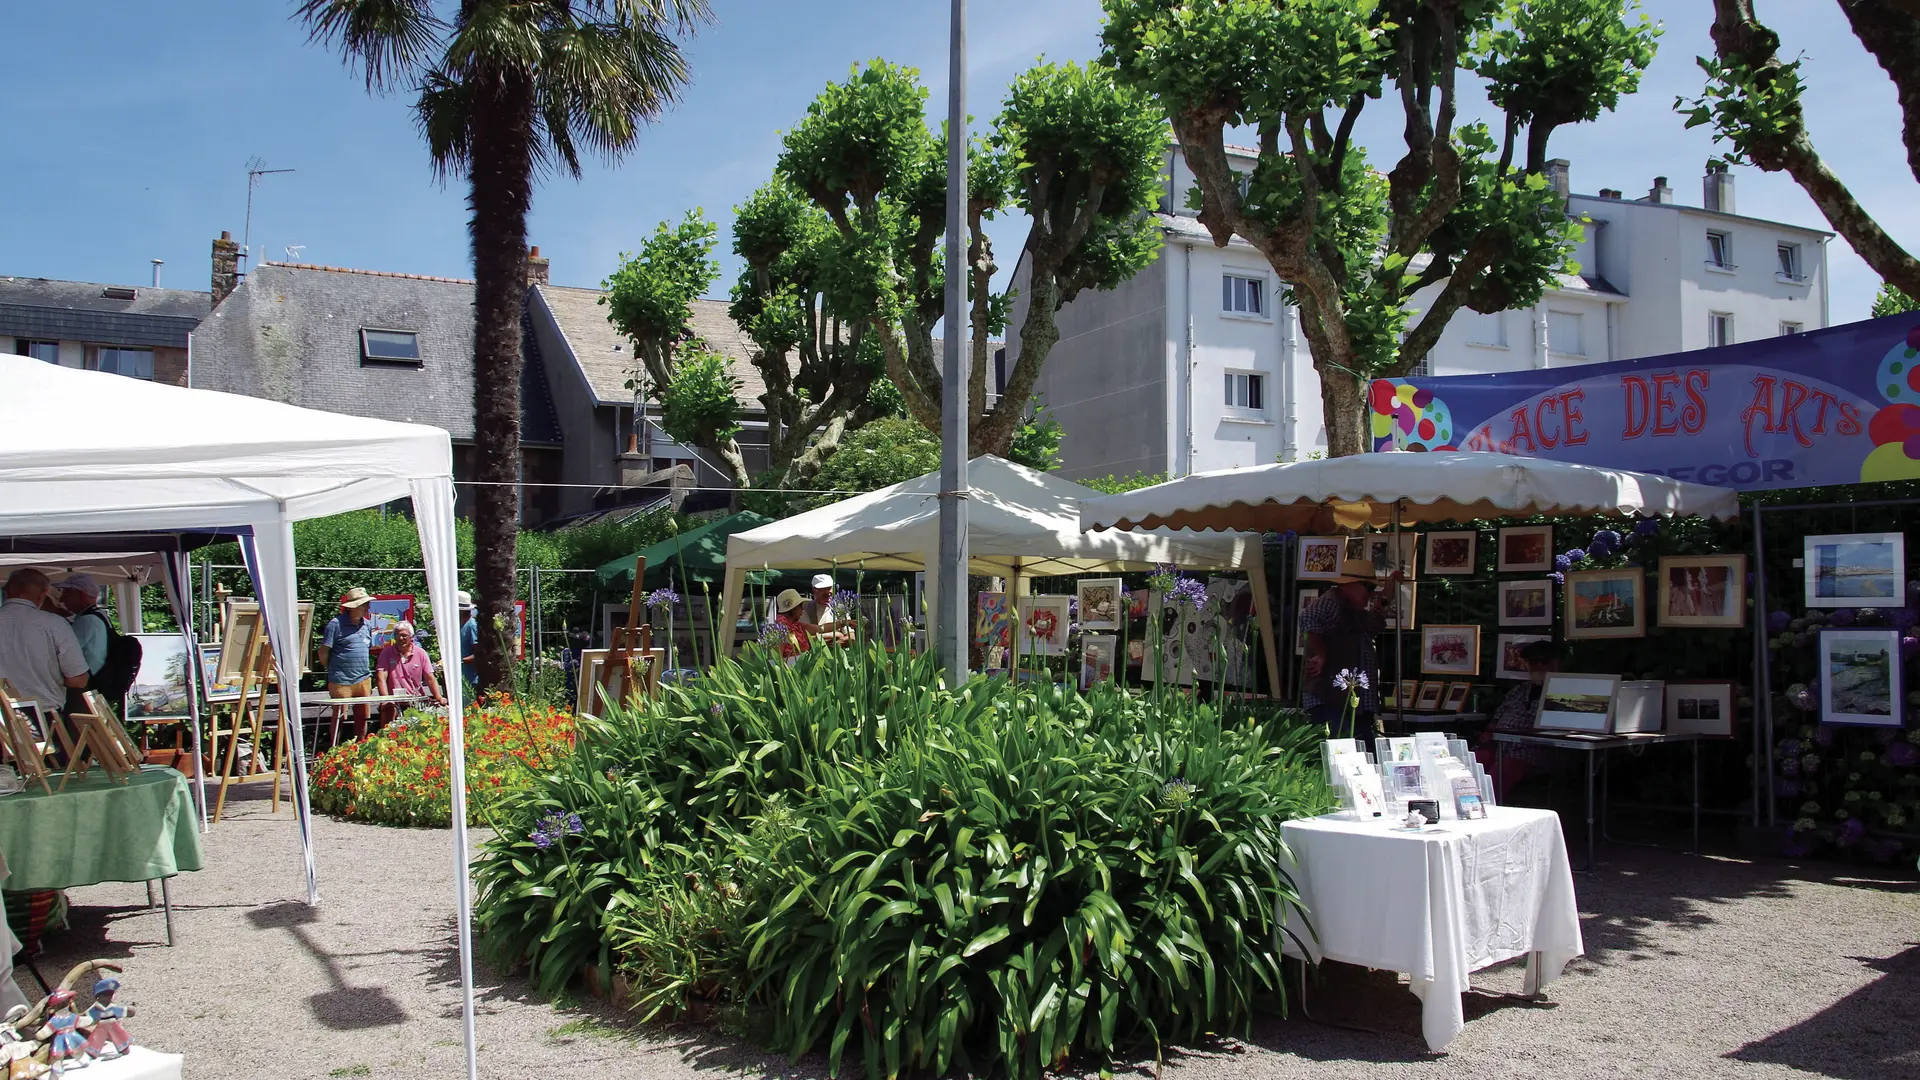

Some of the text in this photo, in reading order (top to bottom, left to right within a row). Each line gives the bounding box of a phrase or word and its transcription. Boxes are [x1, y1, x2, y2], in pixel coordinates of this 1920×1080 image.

[1620, 369, 1710, 441] DES
[1741, 373, 1863, 458] ARTS
[1636, 458, 1796, 486] EGOR
